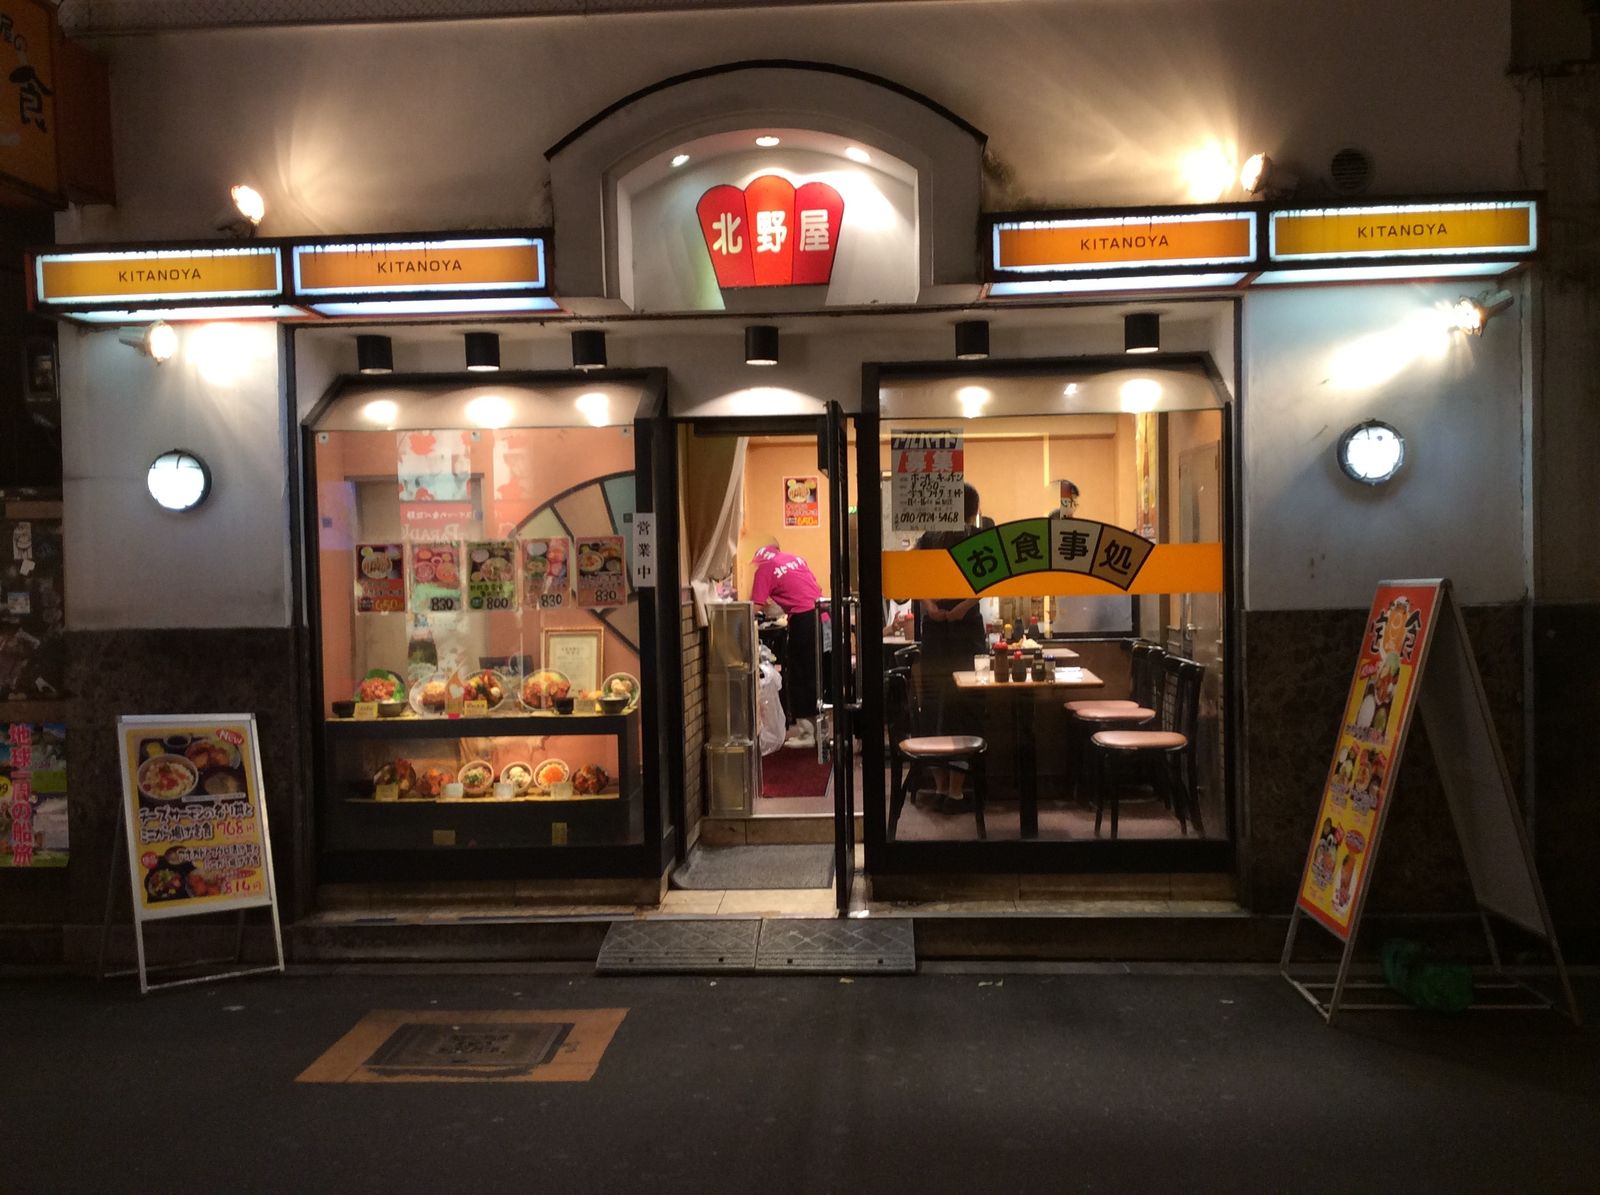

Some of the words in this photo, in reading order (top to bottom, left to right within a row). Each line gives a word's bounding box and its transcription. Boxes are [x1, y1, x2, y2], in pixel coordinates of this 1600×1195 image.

[711, 208, 830, 256] 北野屋
[1357, 222, 1449, 239] KITANOYA
[1080, 235, 1170, 251] KITANOYA
[377, 260, 463, 274] KITANOYA
[118, 268, 202, 283] KITANOYA
[636, 520, 652, 580] 営業中
[967, 529, 1133, 578] お食事処
[430, 596, 455, 611] 830
[486, 597, 509, 610] 800
[540, 593, 563, 608] 830
[594, 590, 617, 602] 830
[8, 722, 32, 866] 地球一周の船旅
